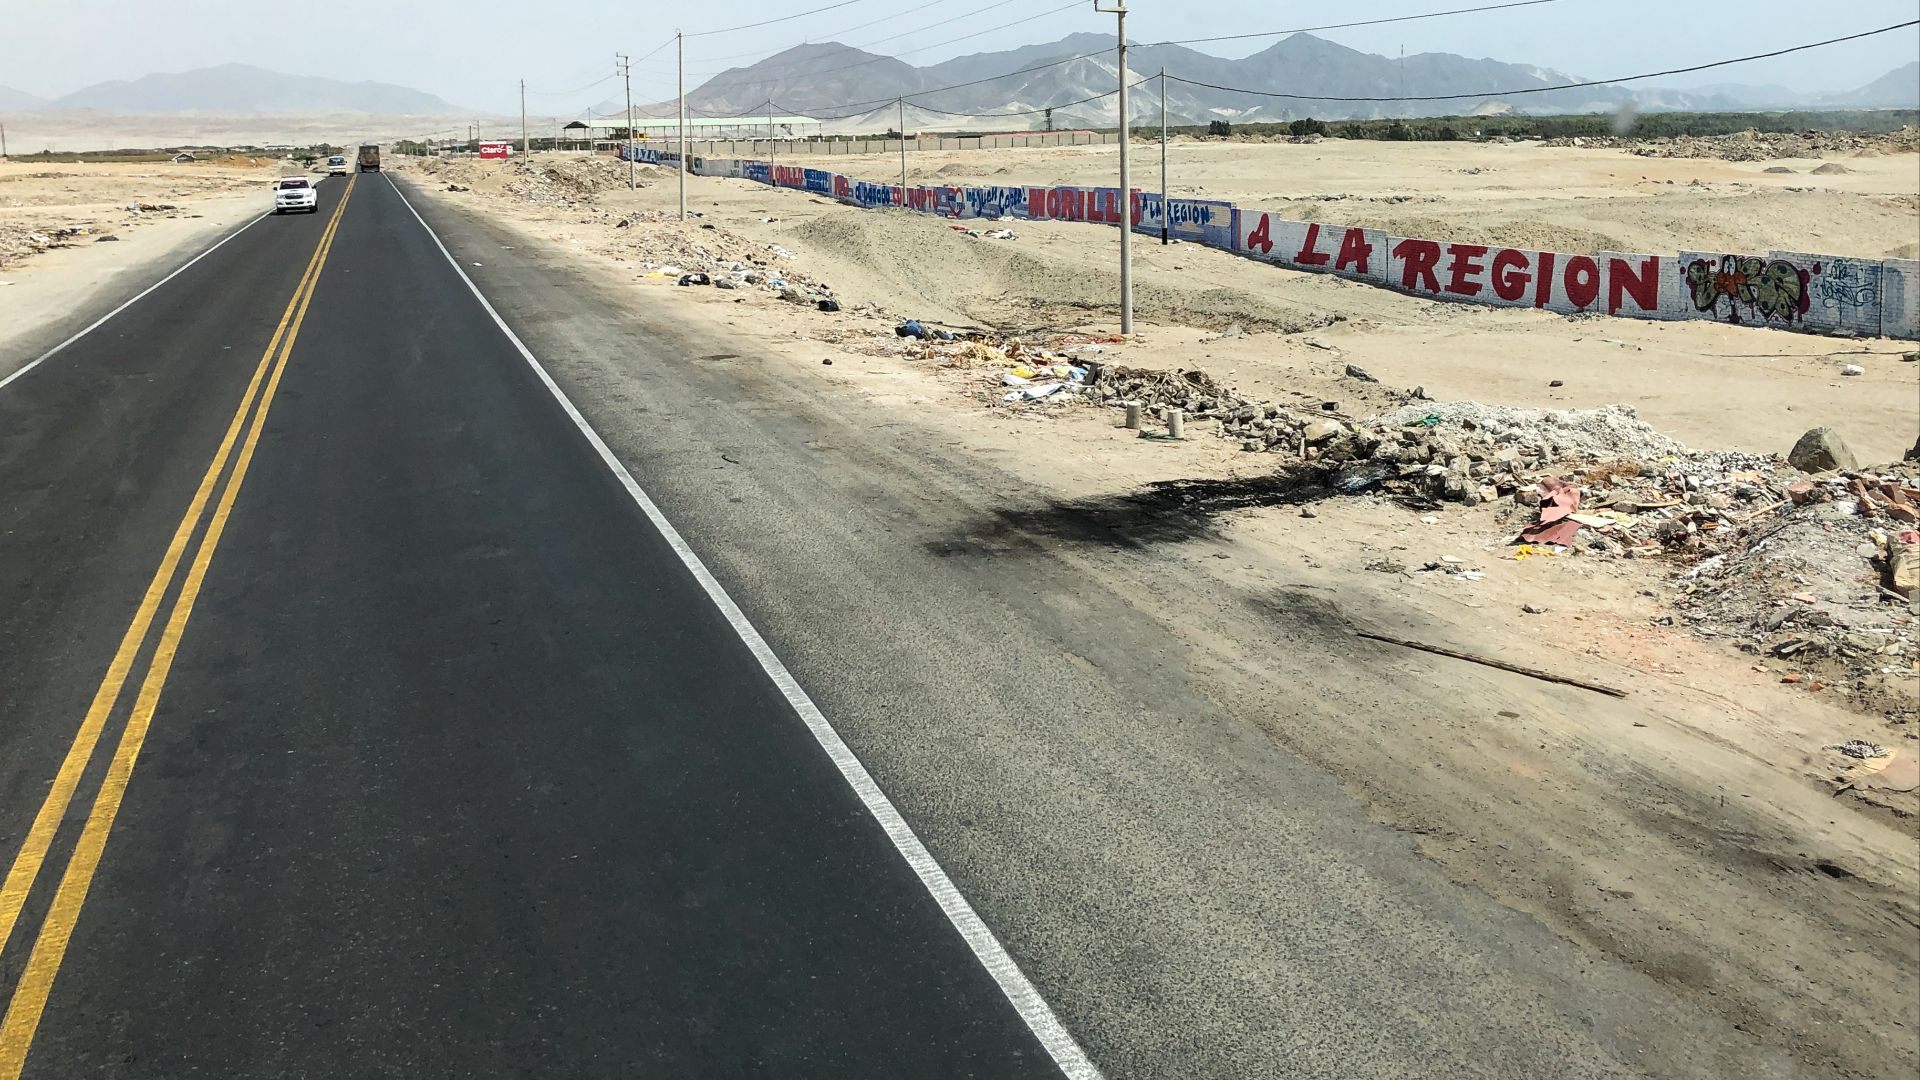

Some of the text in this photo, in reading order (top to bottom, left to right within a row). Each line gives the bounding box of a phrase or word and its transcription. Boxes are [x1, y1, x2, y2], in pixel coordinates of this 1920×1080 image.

[481, 146, 502, 154] Claro
[892, 186, 938, 209] CORUPTO
[1028, 188, 1141, 226] MORILLO
[1142, 194, 1148, 211] A
[1150, 201, 1161, 219] LA
[1247, 212, 1274, 254] A
[1293, 223, 1373, 274] LA
[1392, 238, 1660, 316] REGION
